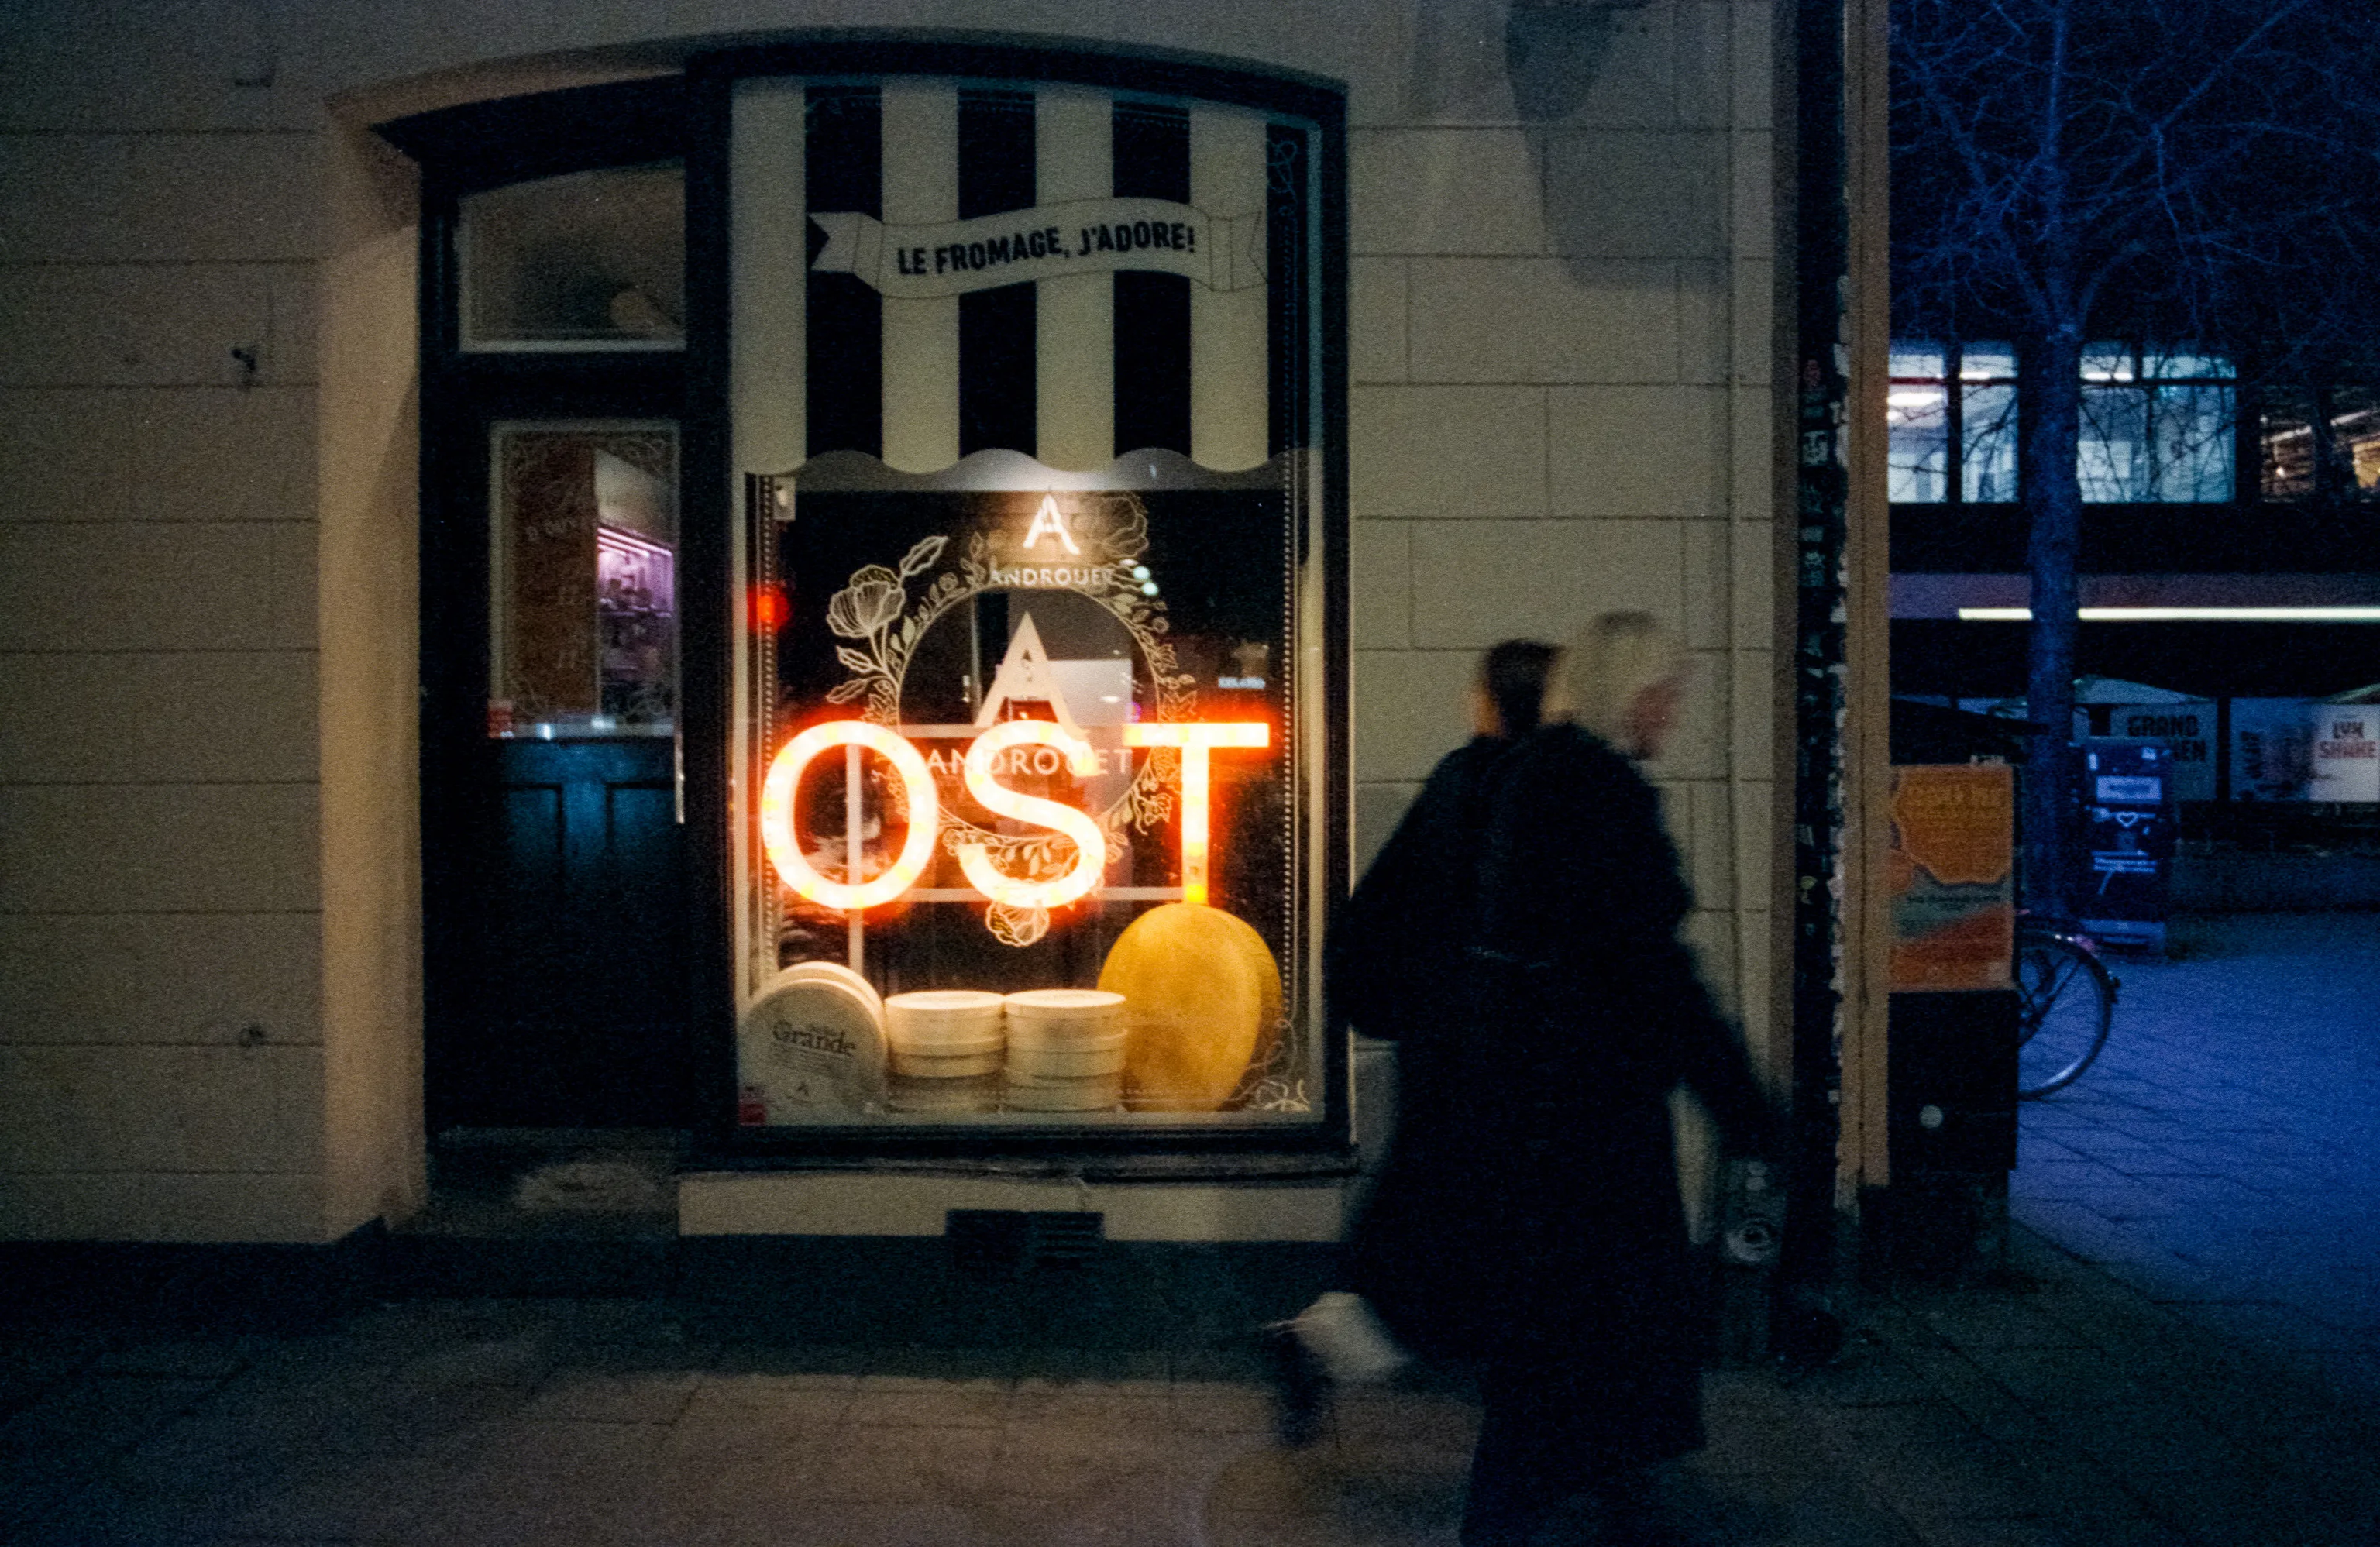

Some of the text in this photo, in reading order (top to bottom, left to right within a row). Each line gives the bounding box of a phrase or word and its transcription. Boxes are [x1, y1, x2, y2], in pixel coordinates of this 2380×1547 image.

[897, 221, 1195, 275] LE FROMAGE, J'ADORE!
[2127, 714, 2199, 737] GRAND
[761, 720, 1270, 909] OST
[772, 1019, 857, 1057] Grande
